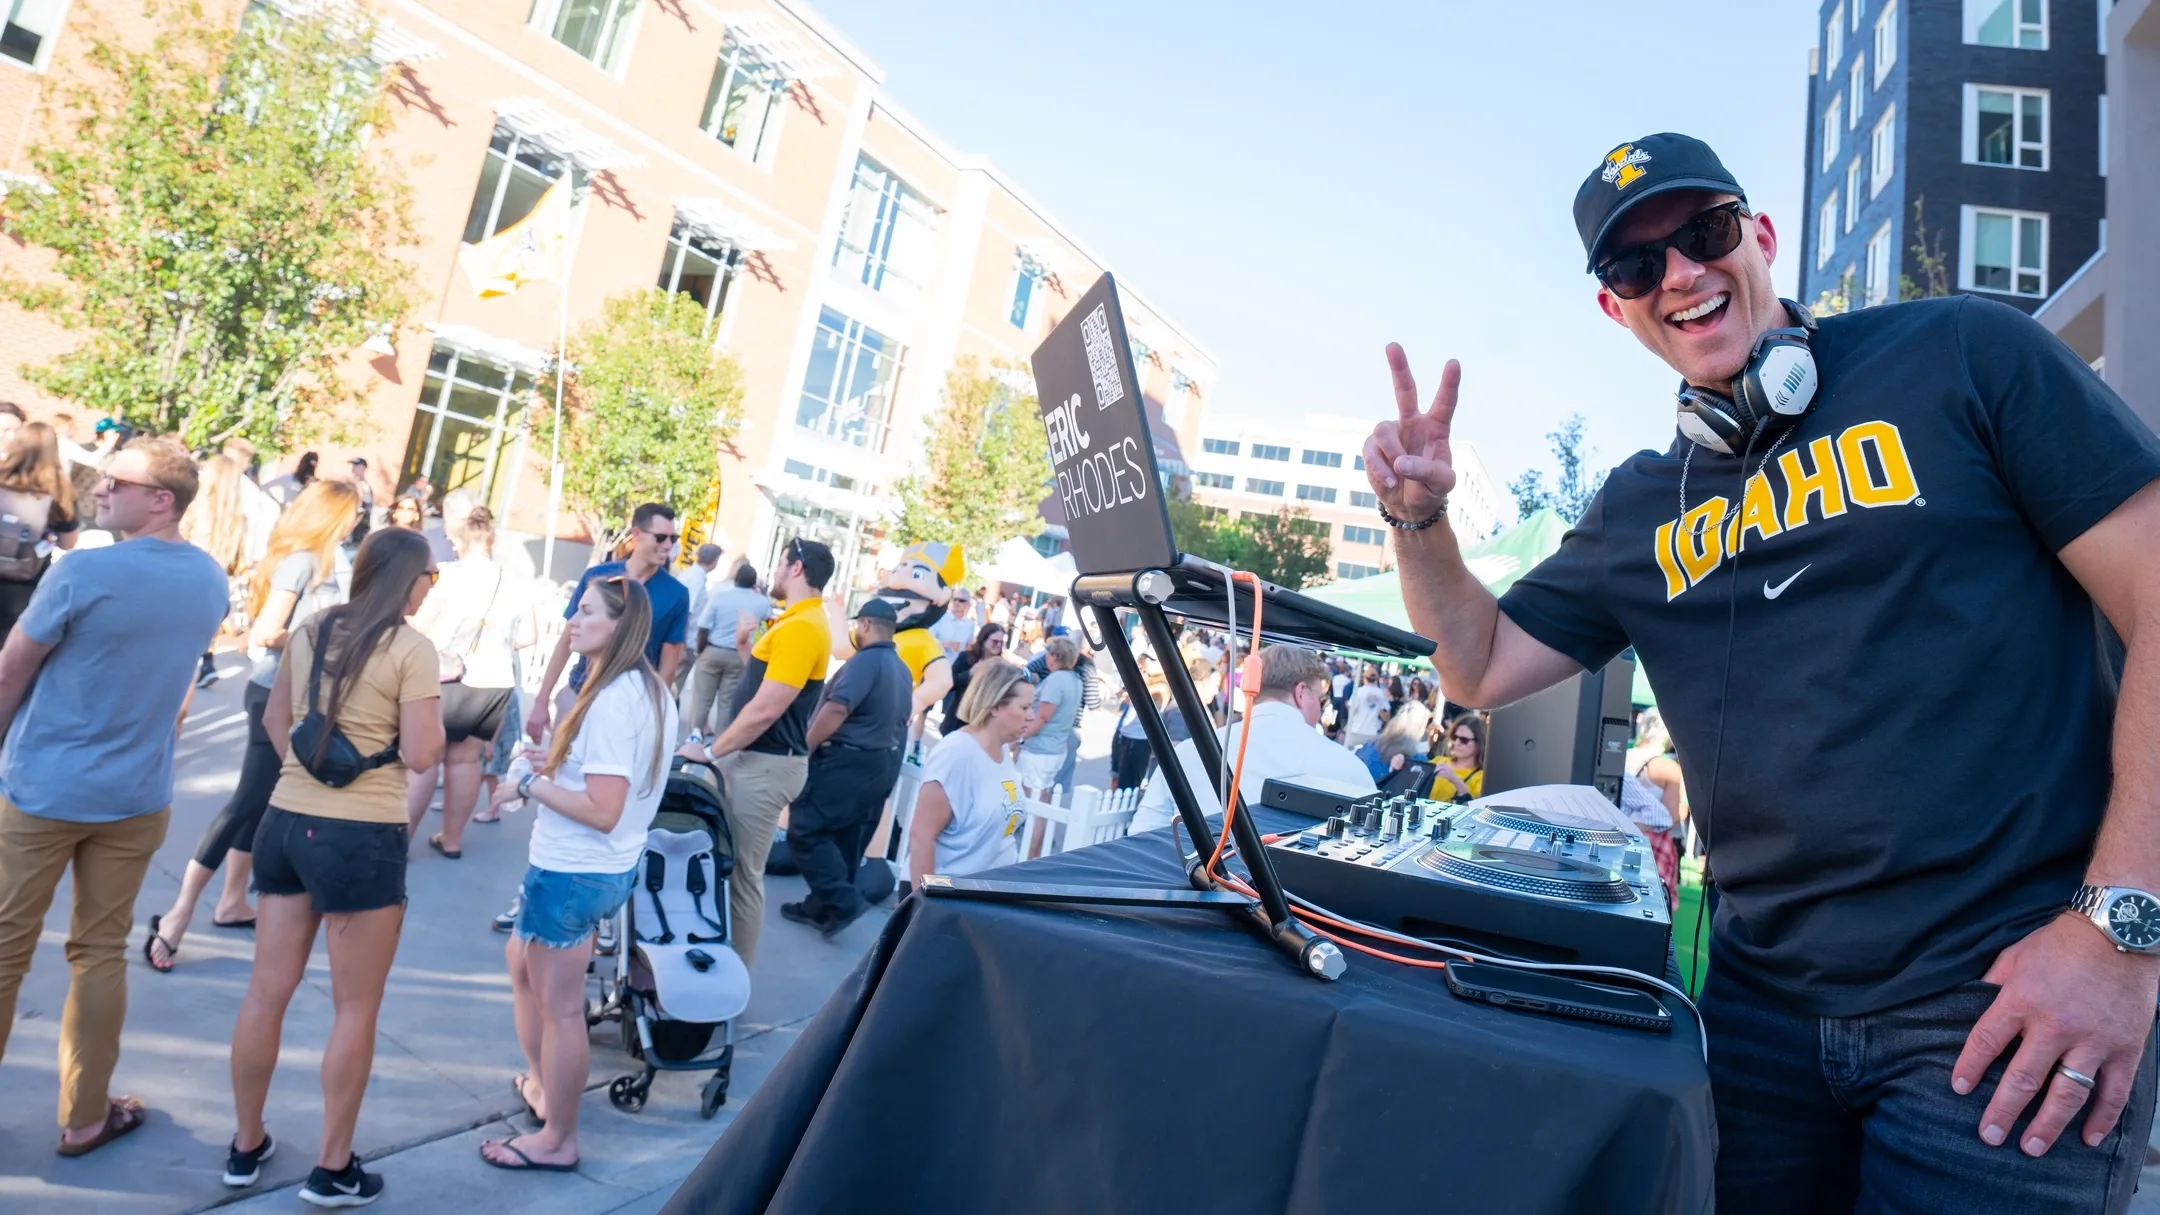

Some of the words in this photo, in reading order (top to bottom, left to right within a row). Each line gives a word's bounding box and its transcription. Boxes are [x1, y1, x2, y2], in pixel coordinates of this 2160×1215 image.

[1045, 393, 1090, 465] ERIC
[1058, 436, 1146, 521] RHODES
[1655, 420, 1920, 602] IDAHO
